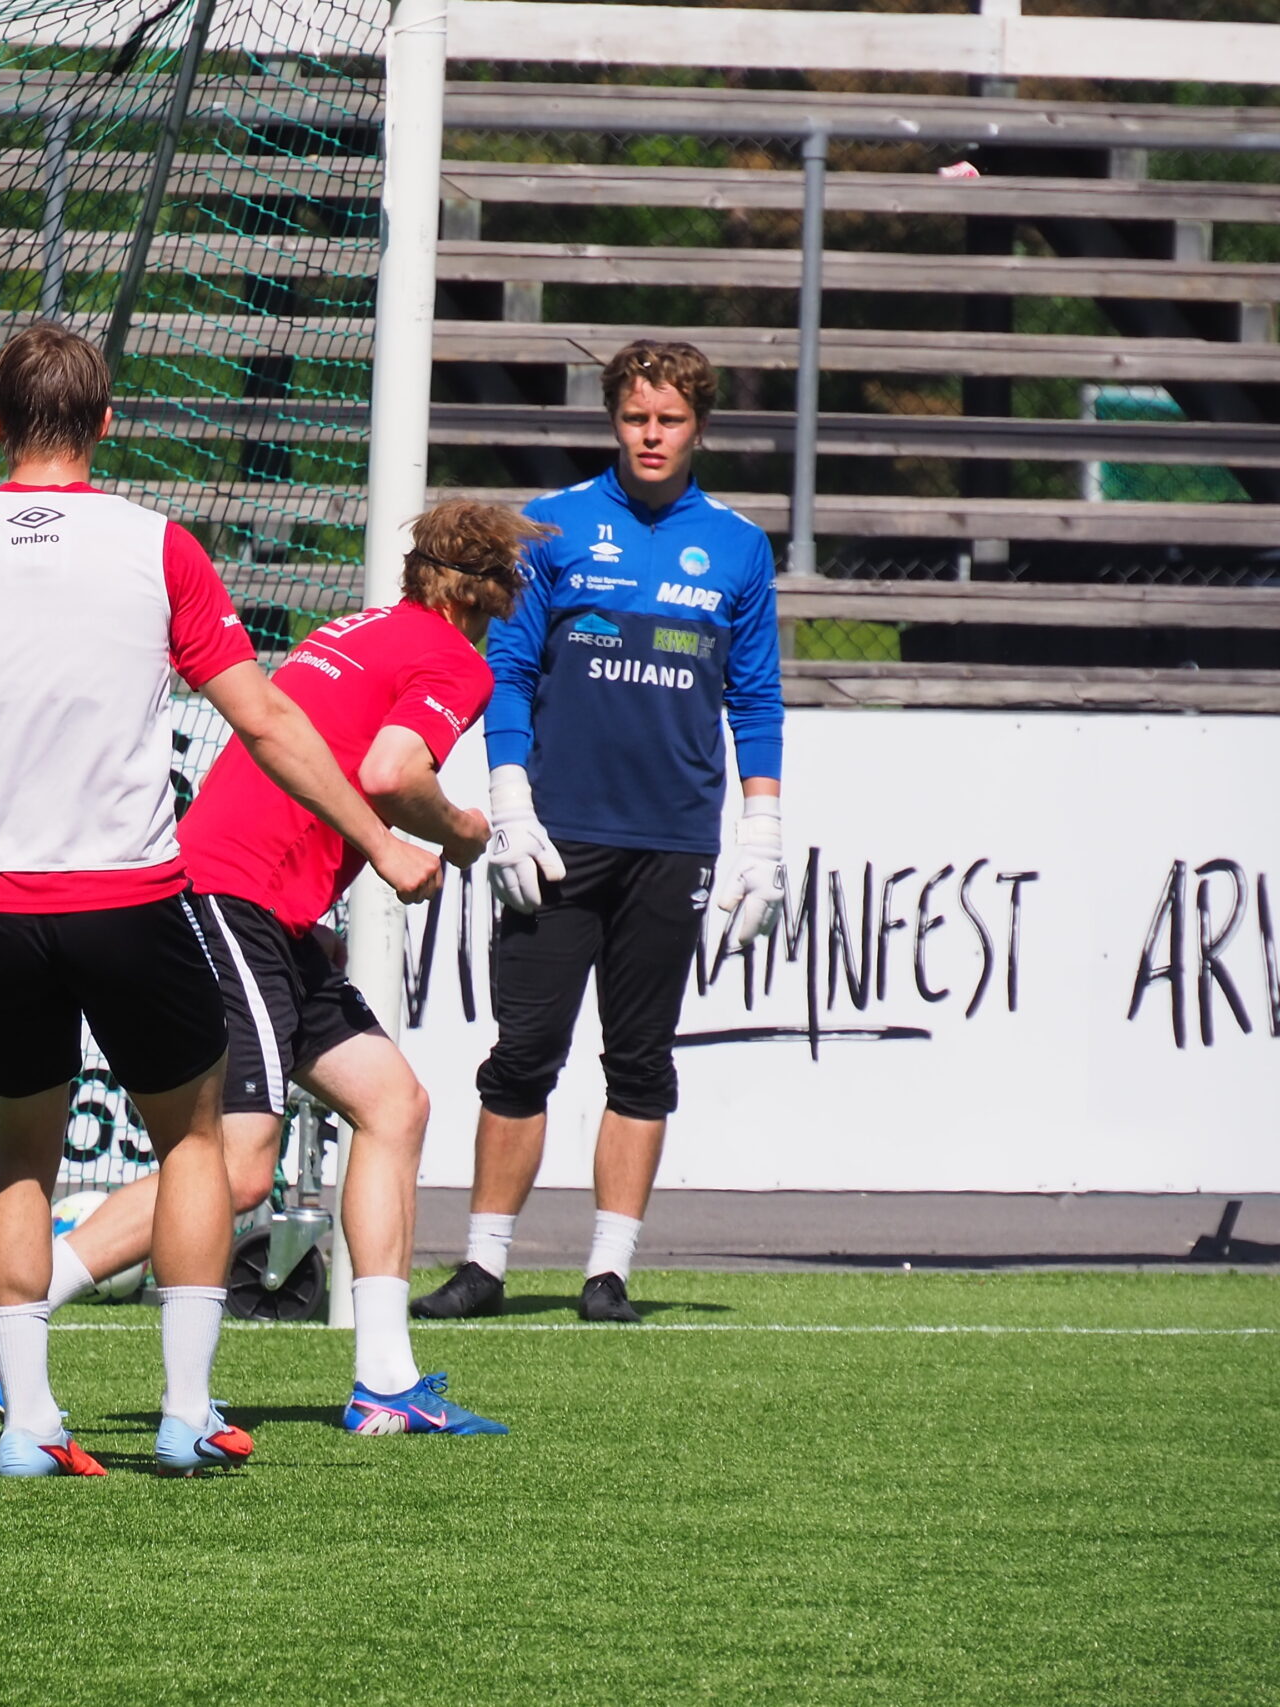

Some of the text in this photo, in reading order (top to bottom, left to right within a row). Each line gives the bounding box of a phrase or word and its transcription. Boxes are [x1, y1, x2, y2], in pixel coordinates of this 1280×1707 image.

[11, 533, 60, 546] umbro
[597, 524, 613, 541] 71
[653, 627, 700, 656] KIWI
